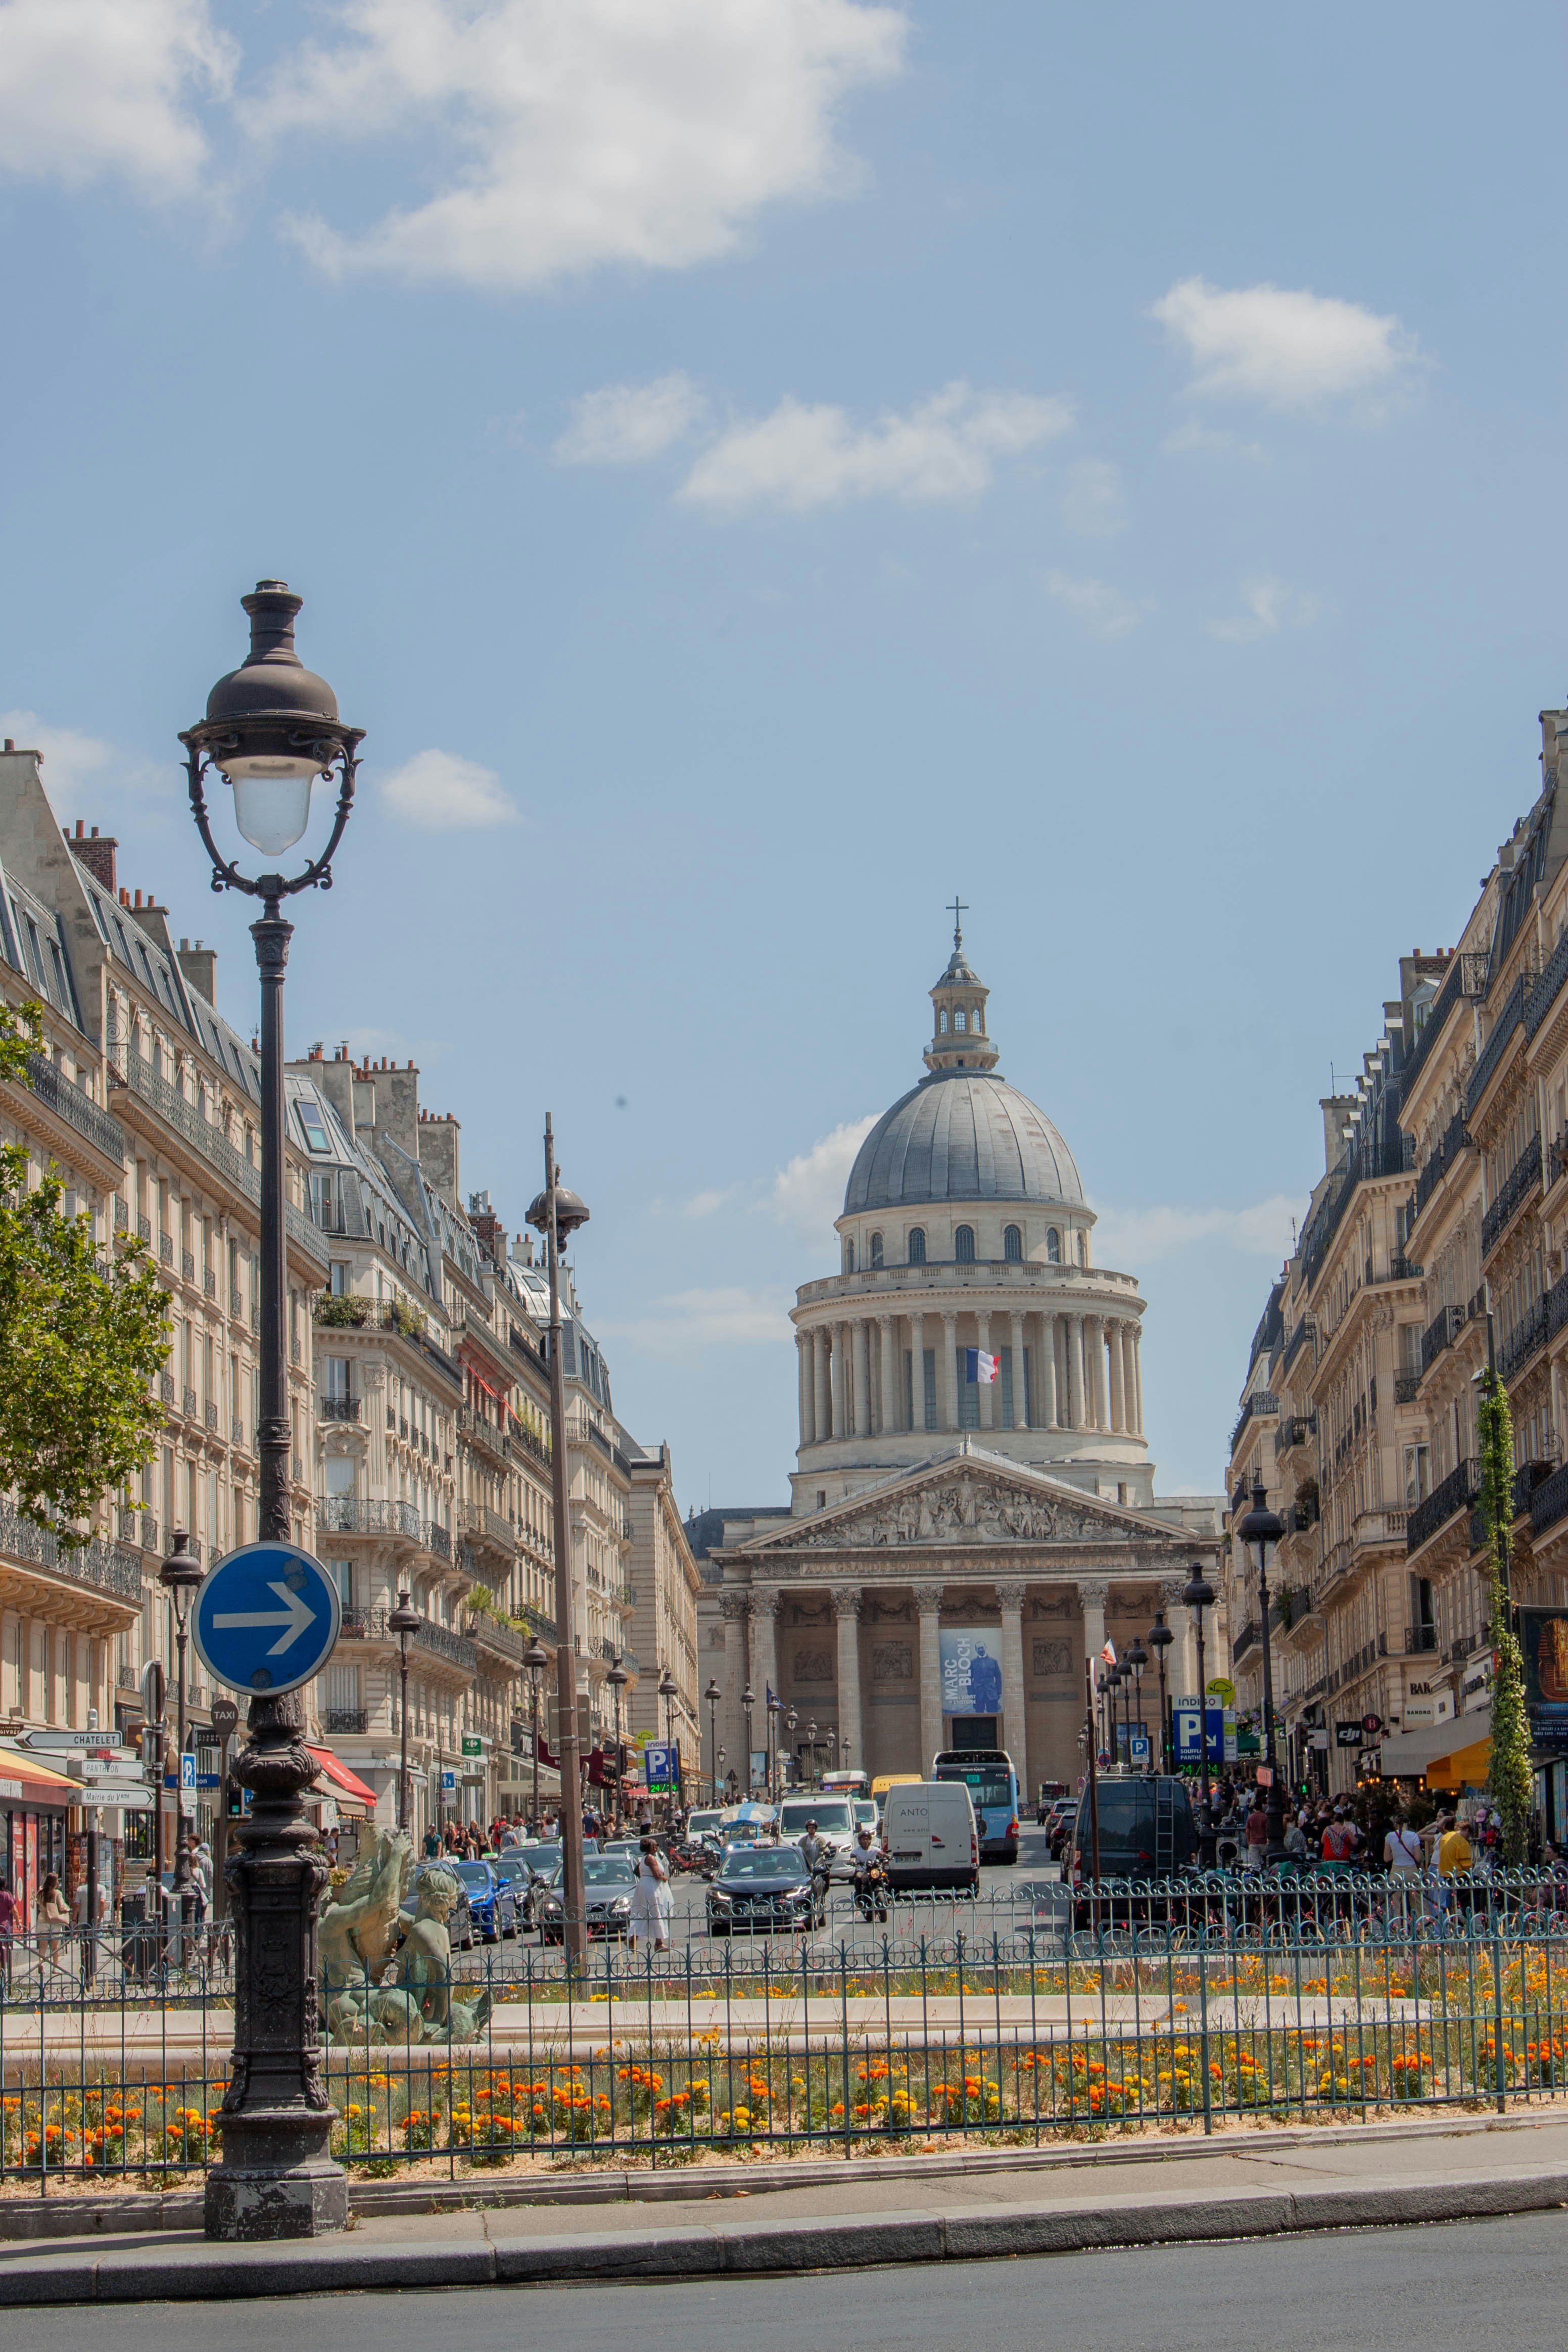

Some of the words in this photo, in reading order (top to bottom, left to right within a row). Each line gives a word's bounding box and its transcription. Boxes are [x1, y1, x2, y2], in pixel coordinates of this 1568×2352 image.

[835, 1561, 887, 1572] GRANDS
[957, 1637, 972, 1686] BLOCH
[944, 1659, 958, 1700] MARC
[1410, 1682, 1432, 1695] BAR
[1178, 1698, 1216, 1707] INDIO
[214, 1711, 235, 1719] TAXI
[1179, 1714, 1202, 1747] P
[74, 1736, 116, 1744] CHATELET
[1135, 1742, 1144, 1753] P
[649, 1751, 667, 1773] P
[86, 1793, 105, 1801] Mairie
[107, 1794, 114, 1802] du
[900, 1808, 928, 1816] ANTO
